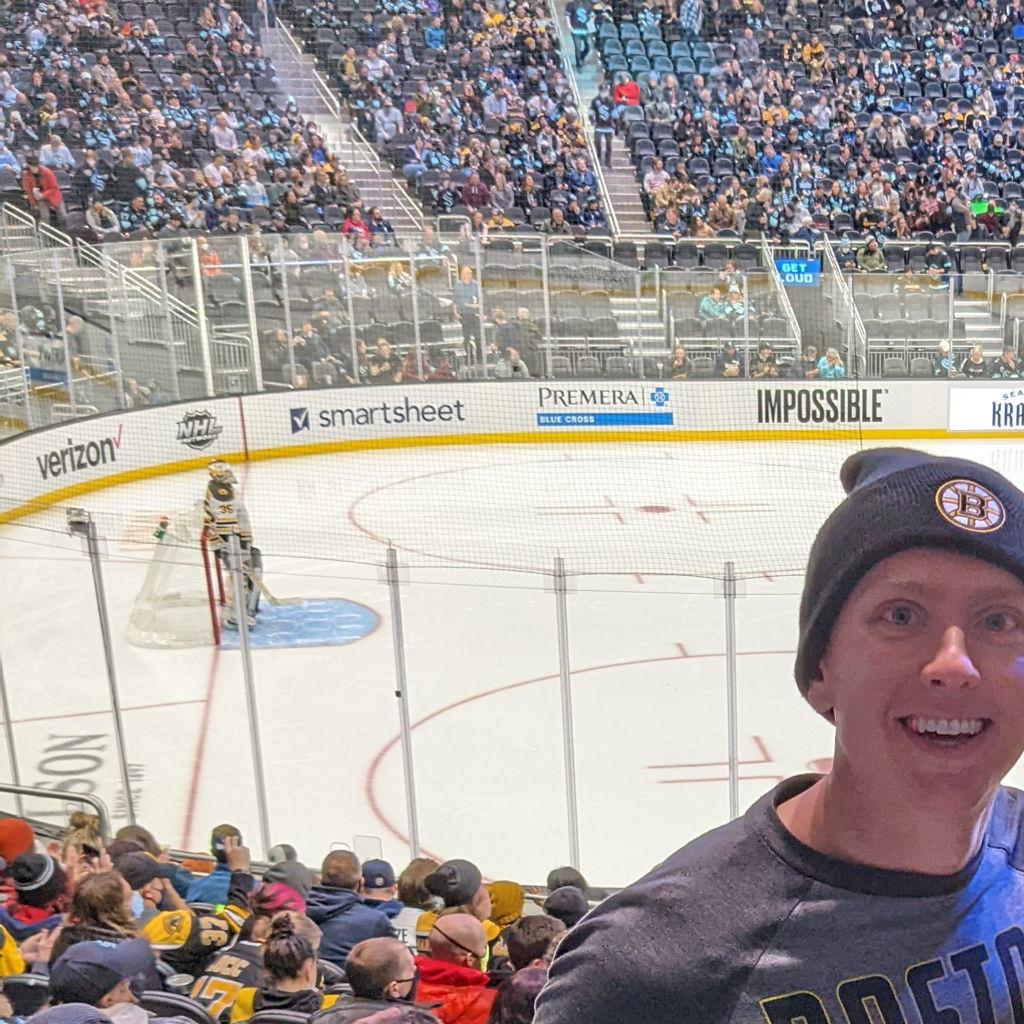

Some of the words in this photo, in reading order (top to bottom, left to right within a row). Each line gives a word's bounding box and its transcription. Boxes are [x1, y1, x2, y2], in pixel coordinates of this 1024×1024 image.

[782, 263, 807, 272] GET
[538, 387, 639, 408] PREMERA
[757, 388, 883, 423] IMPOSSIBLE
[319, 396, 465, 428] smartsheet
[564, 415, 595, 423] CROSS
[176, 416, 223, 440] NHL
[36, 438, 116, 480] verizon
